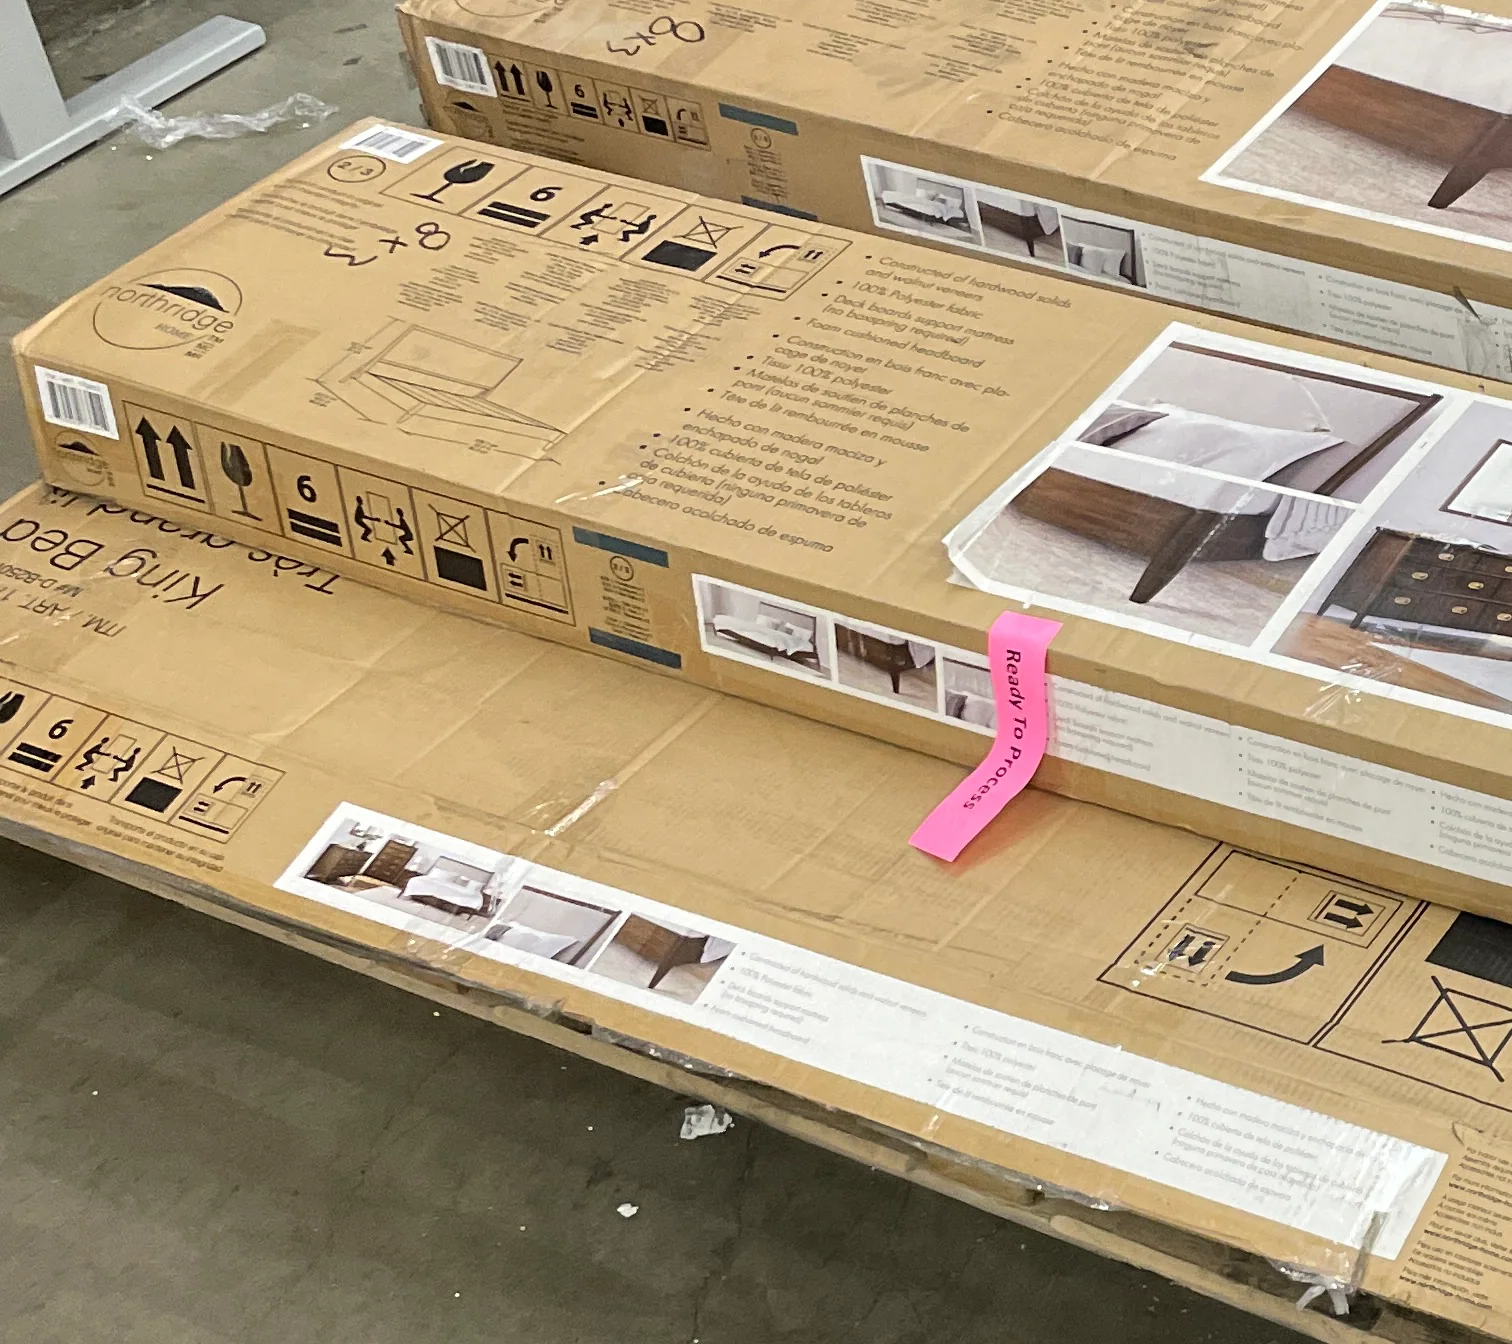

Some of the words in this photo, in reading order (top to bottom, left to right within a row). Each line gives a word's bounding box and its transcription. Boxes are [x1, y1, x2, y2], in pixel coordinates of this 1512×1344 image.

[573, 84, 585, 99] 6
[529, 185, 562, 202] 6
[851, 279, 888, 296] 100%
[887, 288, 946, 309] Polyester
[945, 302, 984, 320] fabric
[863, 268, 895, 280] and
[891, 274, 935, 289] walnut
[935, 285, 984, 302] veneers
[878, 255, 954, 280] Constructed
[951, 273, 971, 283] of
[967, 276, 1038, 300] hardwood
[1035, 294, 1072, 309] solids
[101, 286, 234, 334] northridge
[820, 302, 845, 316] (no
[845, 308, 908, 333] boxspring
[908, 324, 970, 347] required)
[828, 293, 867, 311] Deck
[866, 300, 912, 320] boards
[913, 315, 964, 332] support
[963, 327, 1015, 345] mattress
[773, 345, 809, 359] cage
[808, 352, 829, 364] de
[828, 359, 868, 374] noyer
[786, 334, 863, 360] Construction
[864, 356, 883, 366] en
[882, 357, 912, 373] bois
[913, 364, 948, 382] franc
[948, 376, 983, 391] avec
[980, 385, 1011, 397] pla-
[805, 316, 842, 333] Foam
[842, 328, 911, 350] cushioned
[909, 342, 986, 368] headboard
[760, 354, 792, 370] Tissu
[794, 362, 834, 380] 100%
[829, 375, 893, 395] polyester
[730, 378, 766, 392] pont
[763, 384, 810, 404] (aucun
[810, 399, 867, 418] sommier
[866, 412, 915, 432] requis)
[745, 367, 800, 388] Matelas
[799, 381, 820, 393] de
[820, 388, 867, 405] soutien
[867, 399, 888, 411] de
[887, 405, 949, 427] planches
[949, 420, 970, 433] de
[747, 397, 768, 410] de
[767, 401, 783, 413] lit
[782, 408, 858, 434] rembourrée
[859, 428, 879, 439] en
[878, 434, 930, 452] mousse
[681, 422, 758, 448] enchapado
[759, 441, 780, 454] de
[779, 448, 825, 465] nogal
[695, 407, 742, 427] Hecho
[742, 422, 770, 435] con
[769, 429, 824, 450] madera
[823, 444, 875, 463] maciza
[872, 457, 888, 468] y
[297, 475, 316, 504] 6
[651, 446, 709, 469] Colchón
[709, 463, 731, 476] de
[729, 466, 747, 481] la
[746, 475, 792, 493] ayuda
[792, 485, 813, 499] de
[813, 489, 836, 505] los
[836, 498, 893, 520] tableros
[658, 479, 732, 506] requerida)
[667, 433, 710, 452] 100%
[708, 447, 763, 467] cubierta
[763, 459, 784, 473] de
[784, 466, 812, 481] tela
[812, 473, 833, 486] de
[831, 481, 893, 502] poliéster
[638, 458, 659, 471] de
[659, 465, 715, 486] cubierta
[714, 478, 775, 503] (ninguna
[772, 497, 846, 522] primavera
[845, 514, 868, 528] de
[681, 505, 756, 531] acolchado
[756, 523, 778, 537] de
[778, 532, 834, 553] espuma
[104, 548, 225, 611] King
[1006, 649, 1025, 710] Ready
[48, 719, 74, 739] 6
[1013, 717, 1027, 740] To
[963, 746, 1022, 810] Process
